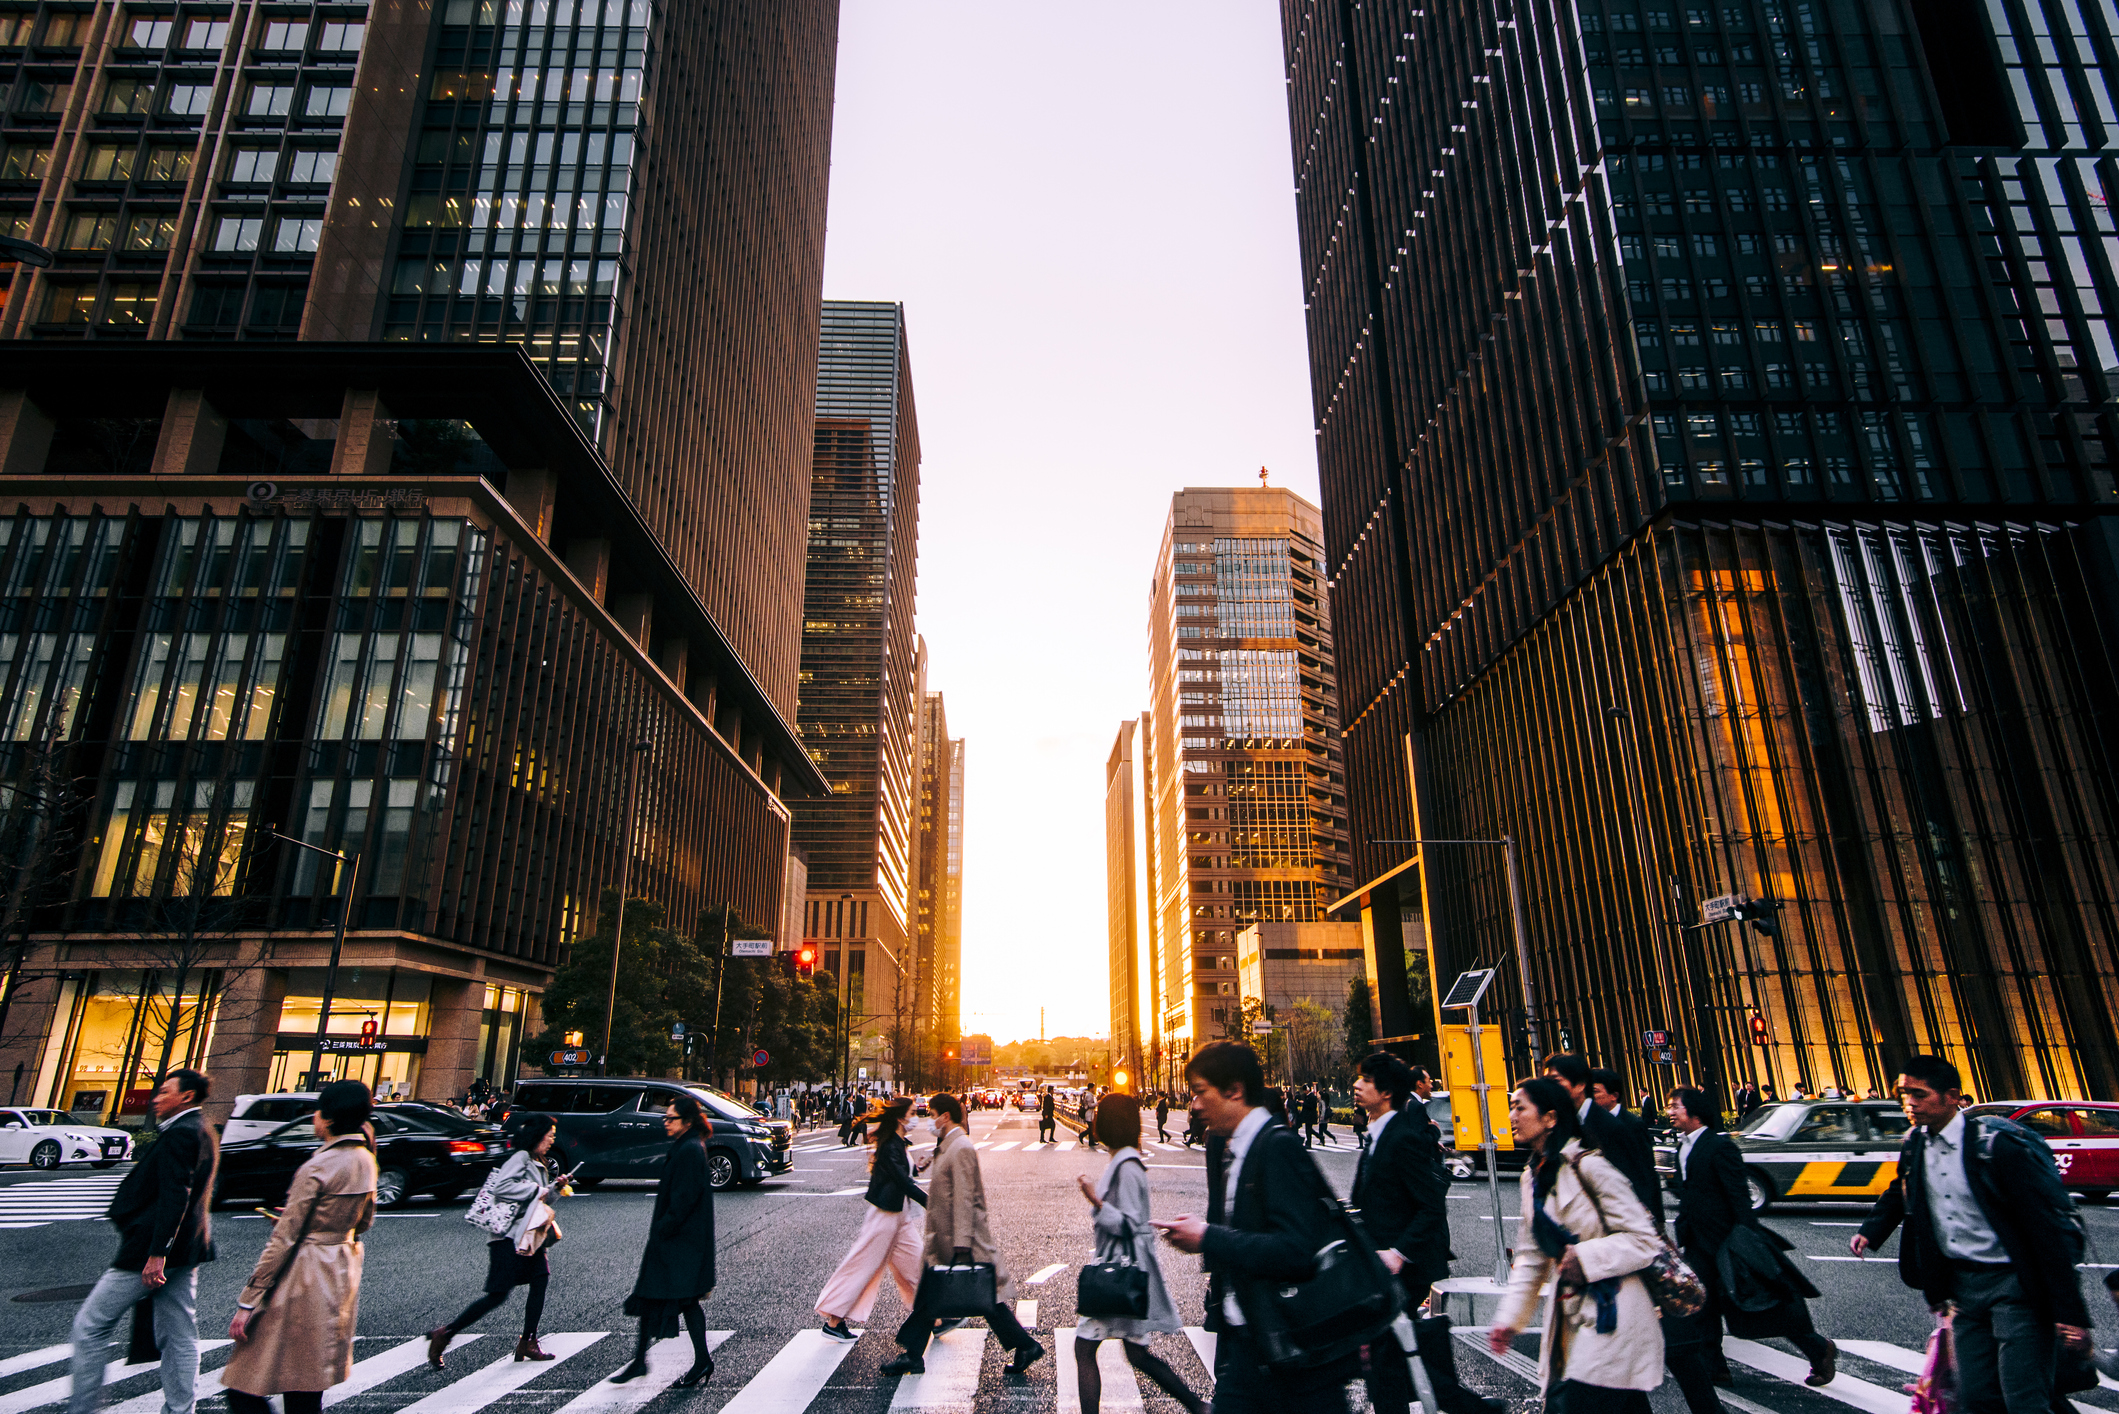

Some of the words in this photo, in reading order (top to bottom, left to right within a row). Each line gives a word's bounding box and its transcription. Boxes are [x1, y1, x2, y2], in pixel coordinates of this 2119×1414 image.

[285, 488, 423, 502] 三菱東京UFJ銀行
[1705, 898, 1730, 912] 大手町駅前
[563, 1053, 577, 1062] 402
[1660, 1052, 1672, 1060] 402
